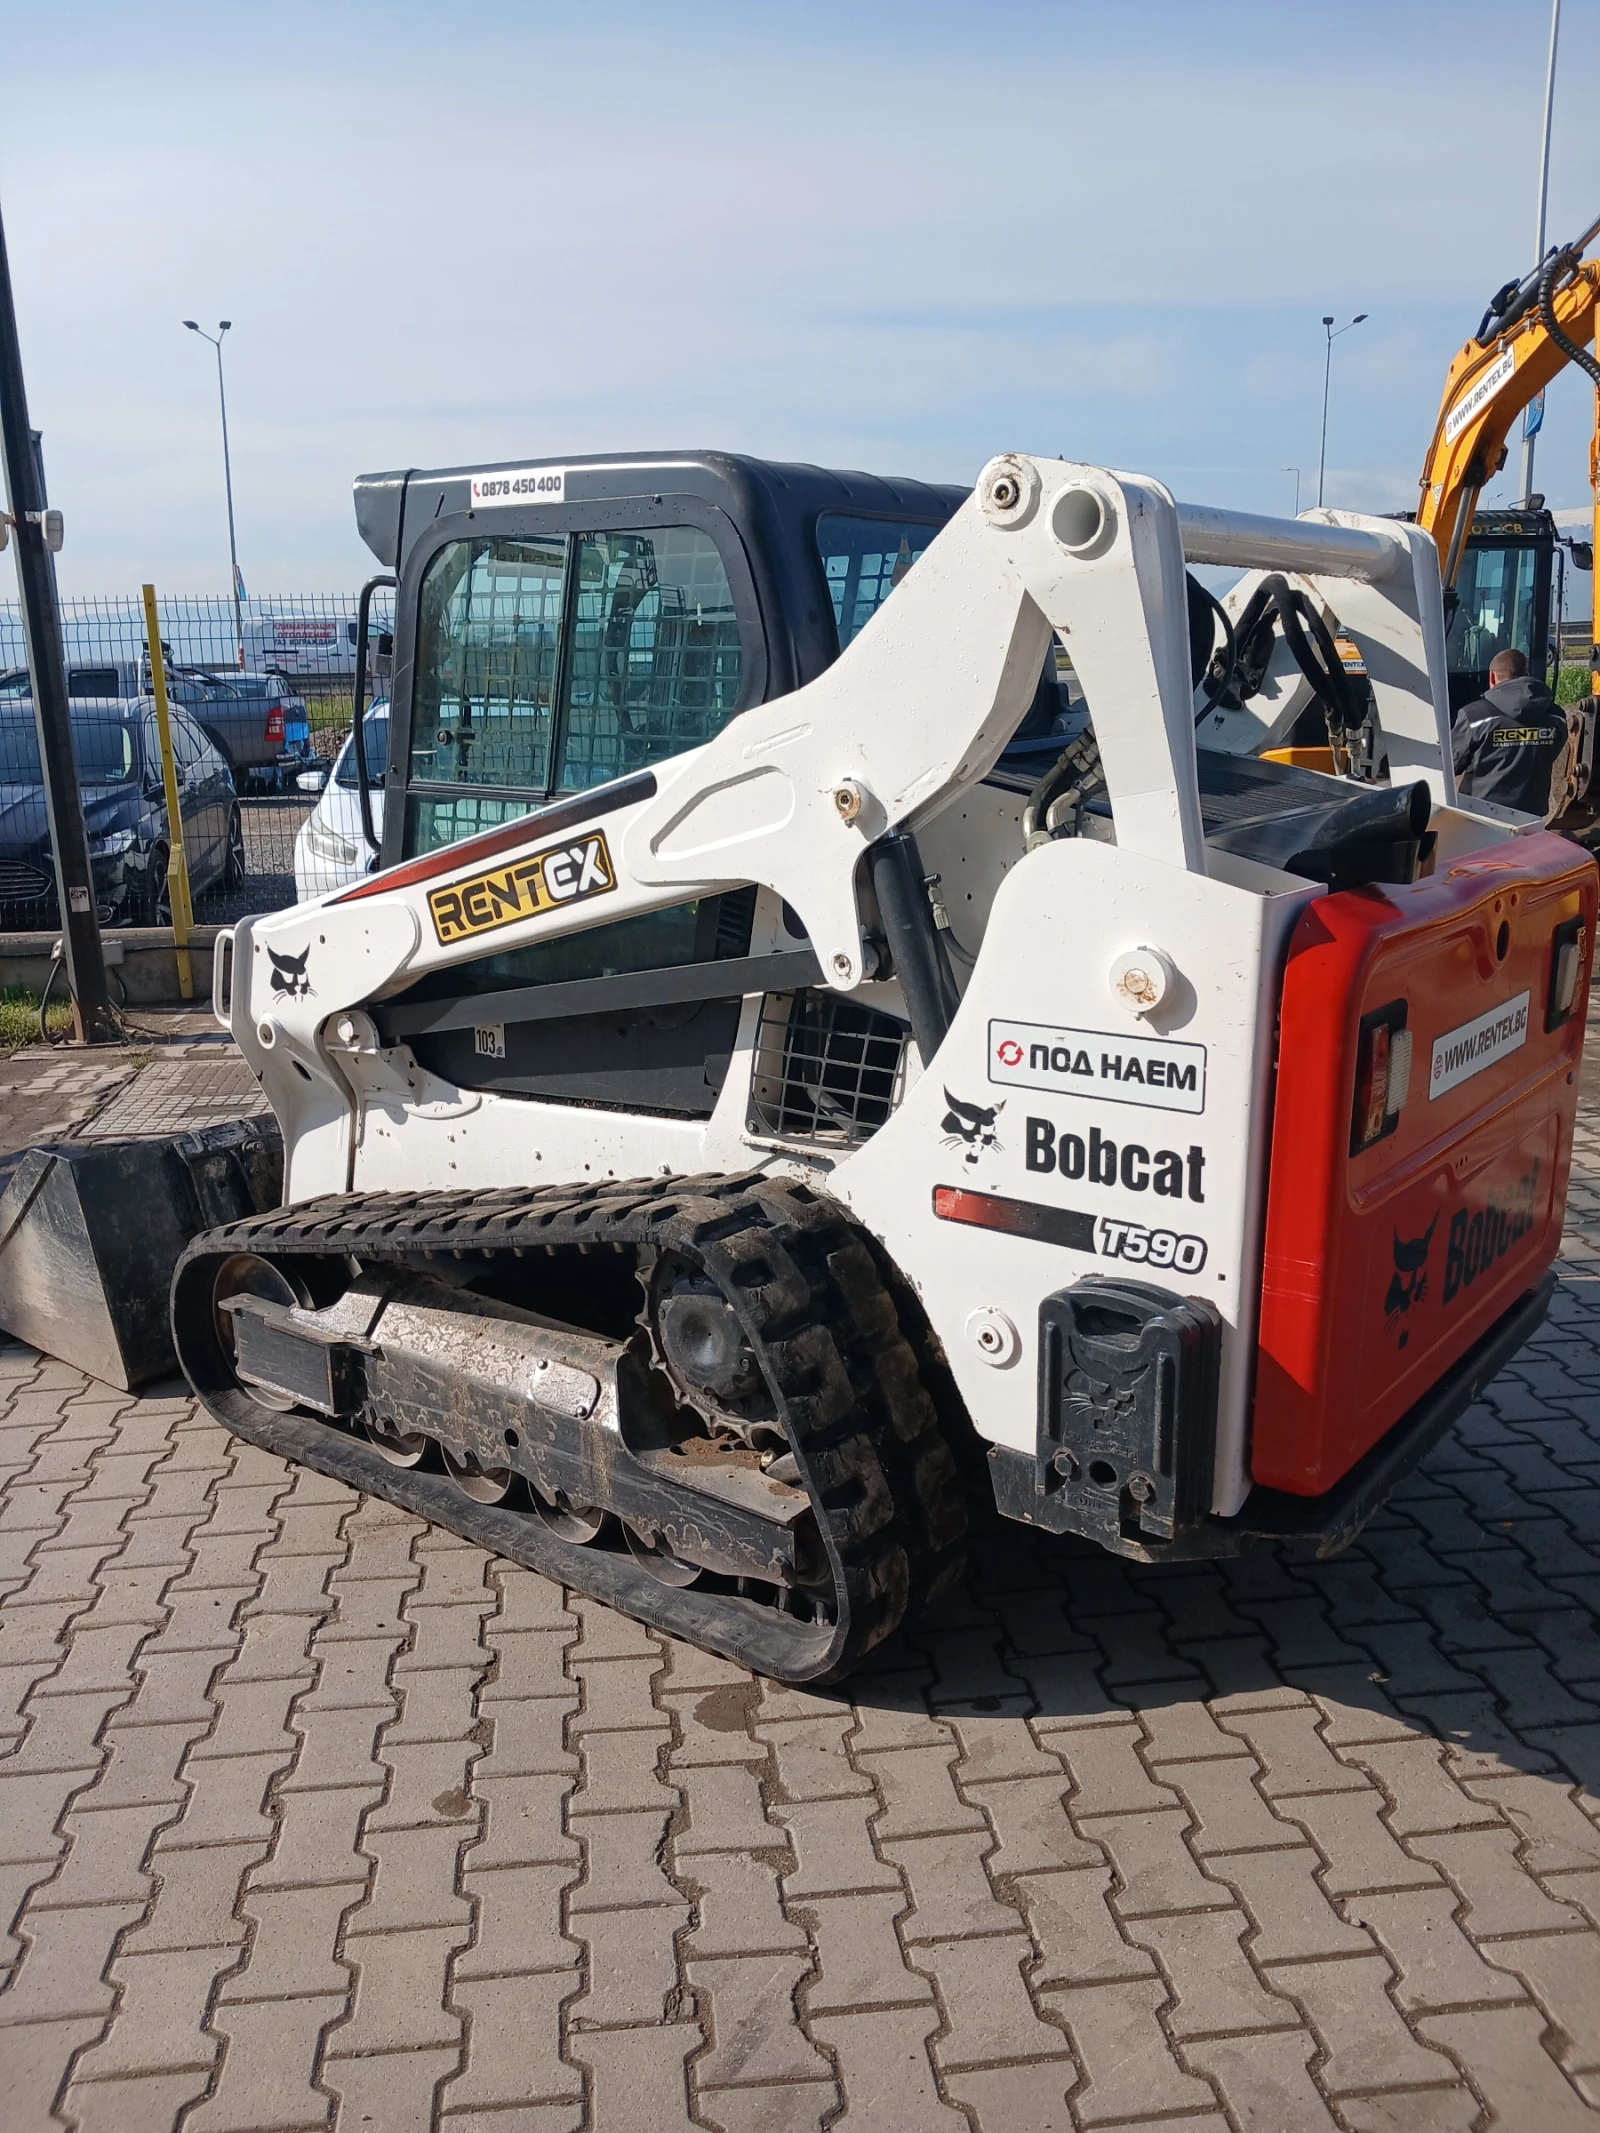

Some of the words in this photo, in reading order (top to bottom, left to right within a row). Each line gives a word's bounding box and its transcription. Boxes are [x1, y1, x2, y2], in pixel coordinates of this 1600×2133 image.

[482, 480, 510, 496] 0878
[512, 478, 536, 493] 450
[537, 475, 561, 491] 400
[1494, 727, 1556, 741] RENTEX
[434, 841, 608, 937] RENTEX
[476, 1029, 496, 1054] 103
[1445, 1006, 1527, 1074] WWW.RENTEX.BG
[1029, 1044, 1094, 1076] ПОД
[1100, 1053, 1197, 1092] НАЕМ
[1025, 1115, 1206, 1204] Bobcat
[1101, 1219, 1207, 1274] T590
[1441, 1155, 1541, 1308] Bobcat
